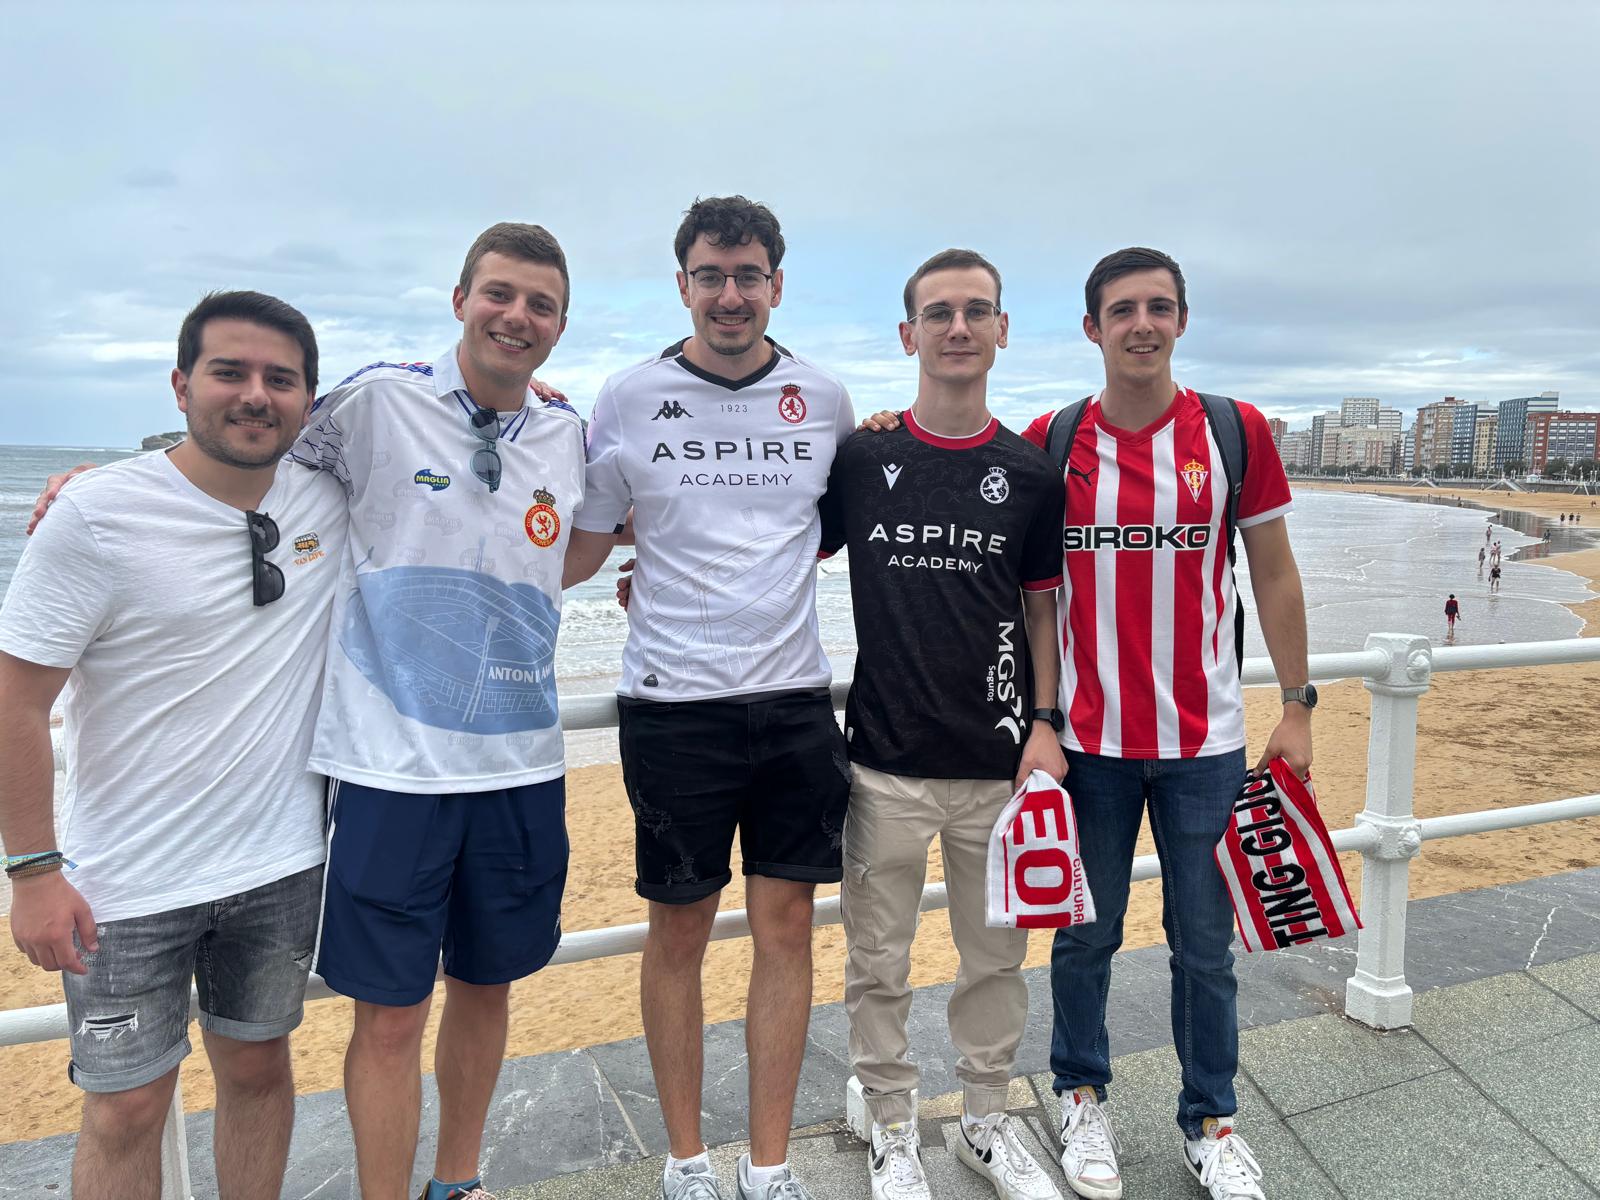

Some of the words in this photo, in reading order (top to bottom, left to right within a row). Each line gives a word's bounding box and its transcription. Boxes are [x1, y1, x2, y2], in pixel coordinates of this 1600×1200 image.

[720, 403, 748, 413] 1923
[415, 475, 449, 485] MAGLIA
[679, 473, 793, 486] ACADEMY
[1064, 525, 1211, 550] SIROKO
[887, 554, 984, 574] ACADEMY
[997, 621, 1016, 702] MGS
[986, 665, 997, 702] Seguros
[1233, 769, 1293, 857] GIJO
[1073, 858, 1085, 926] CULTURA
